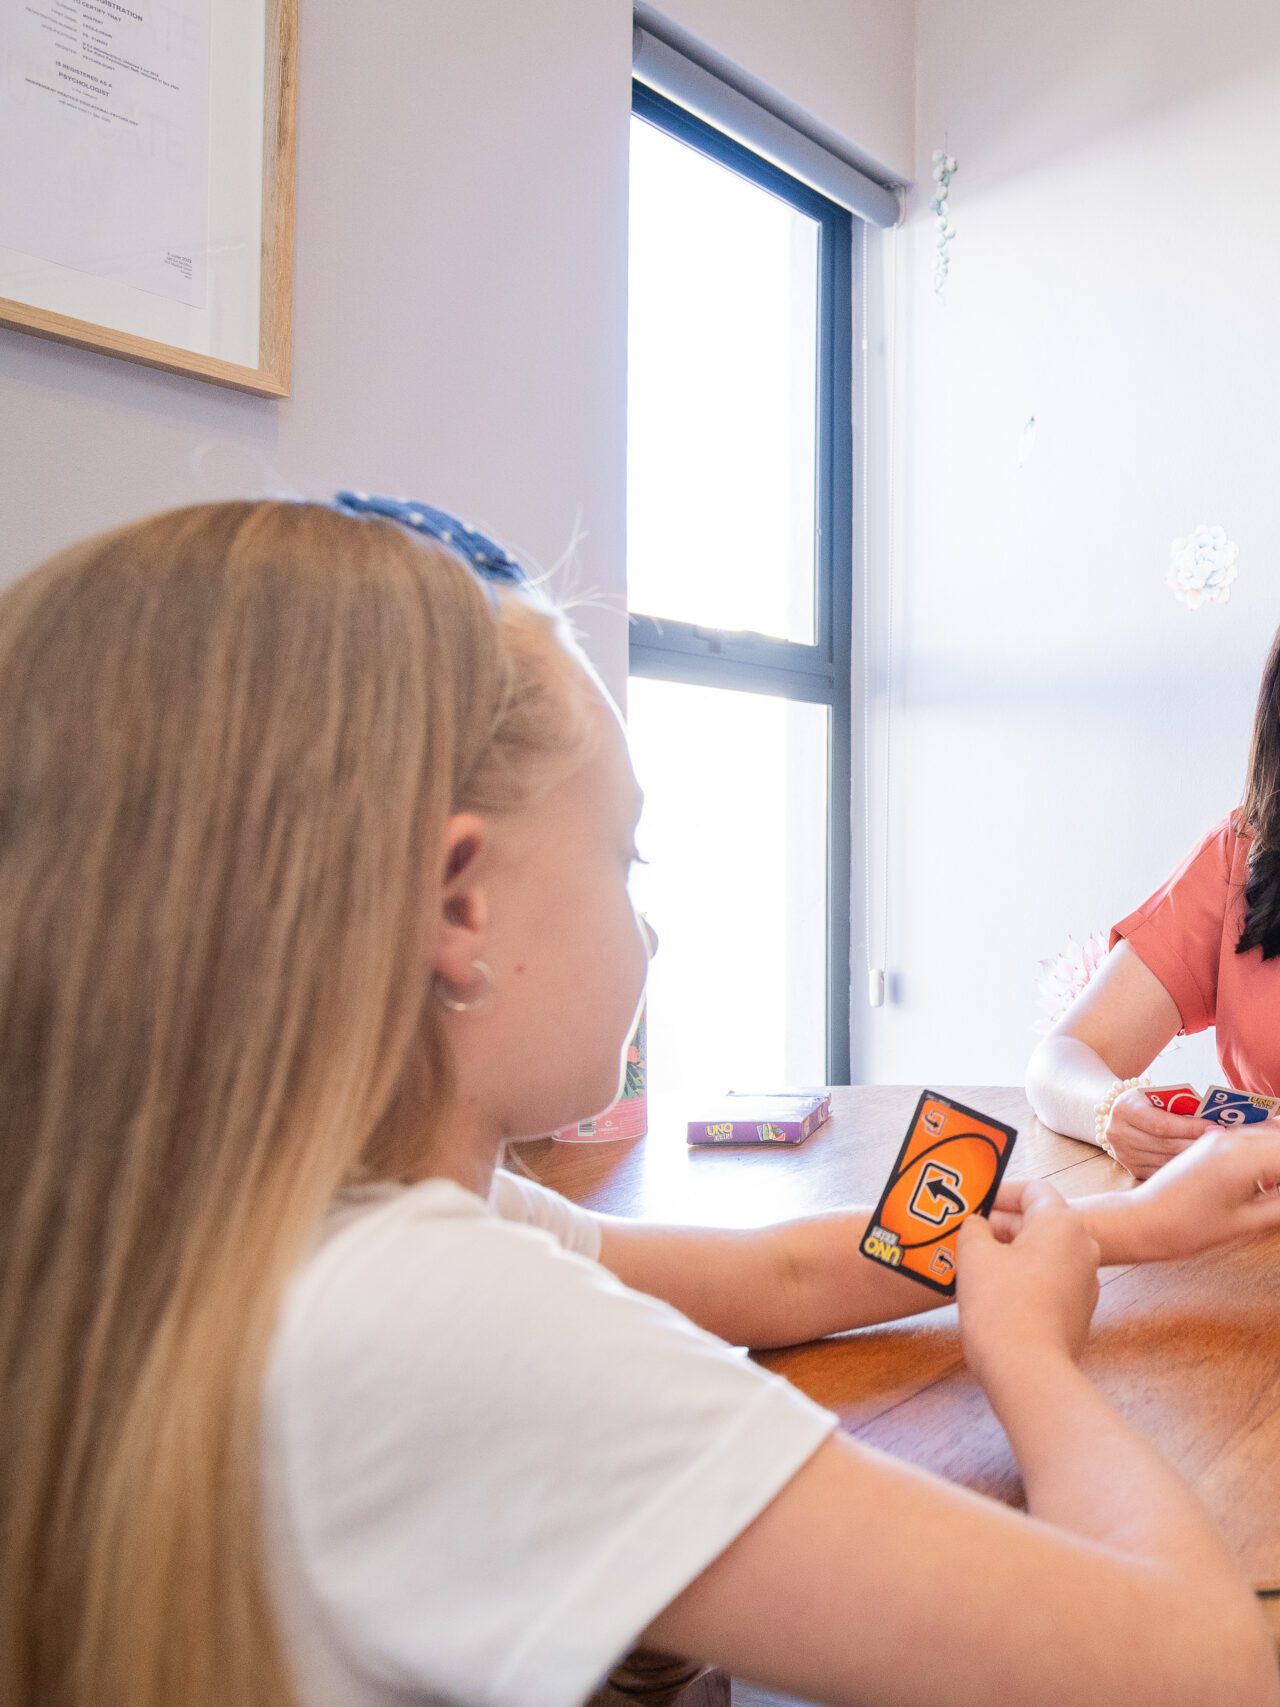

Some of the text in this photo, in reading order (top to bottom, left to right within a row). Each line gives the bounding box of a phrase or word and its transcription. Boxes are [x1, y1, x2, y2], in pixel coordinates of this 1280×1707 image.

[81, 1, 106, 15] CERTIFY
[62, 63, 99, 82] REGISTERED
[58, 71, 110, 97] PSYCHOLOGIST
[1150, 1094, 1165, 1107] 8
[1214, 1092, 1228, 1102] 9
[1217, 1108, 1246, 1127] 9
[706, 1123, 734, 1137] UNO
[864, 1236, 901, 1266] UNO
